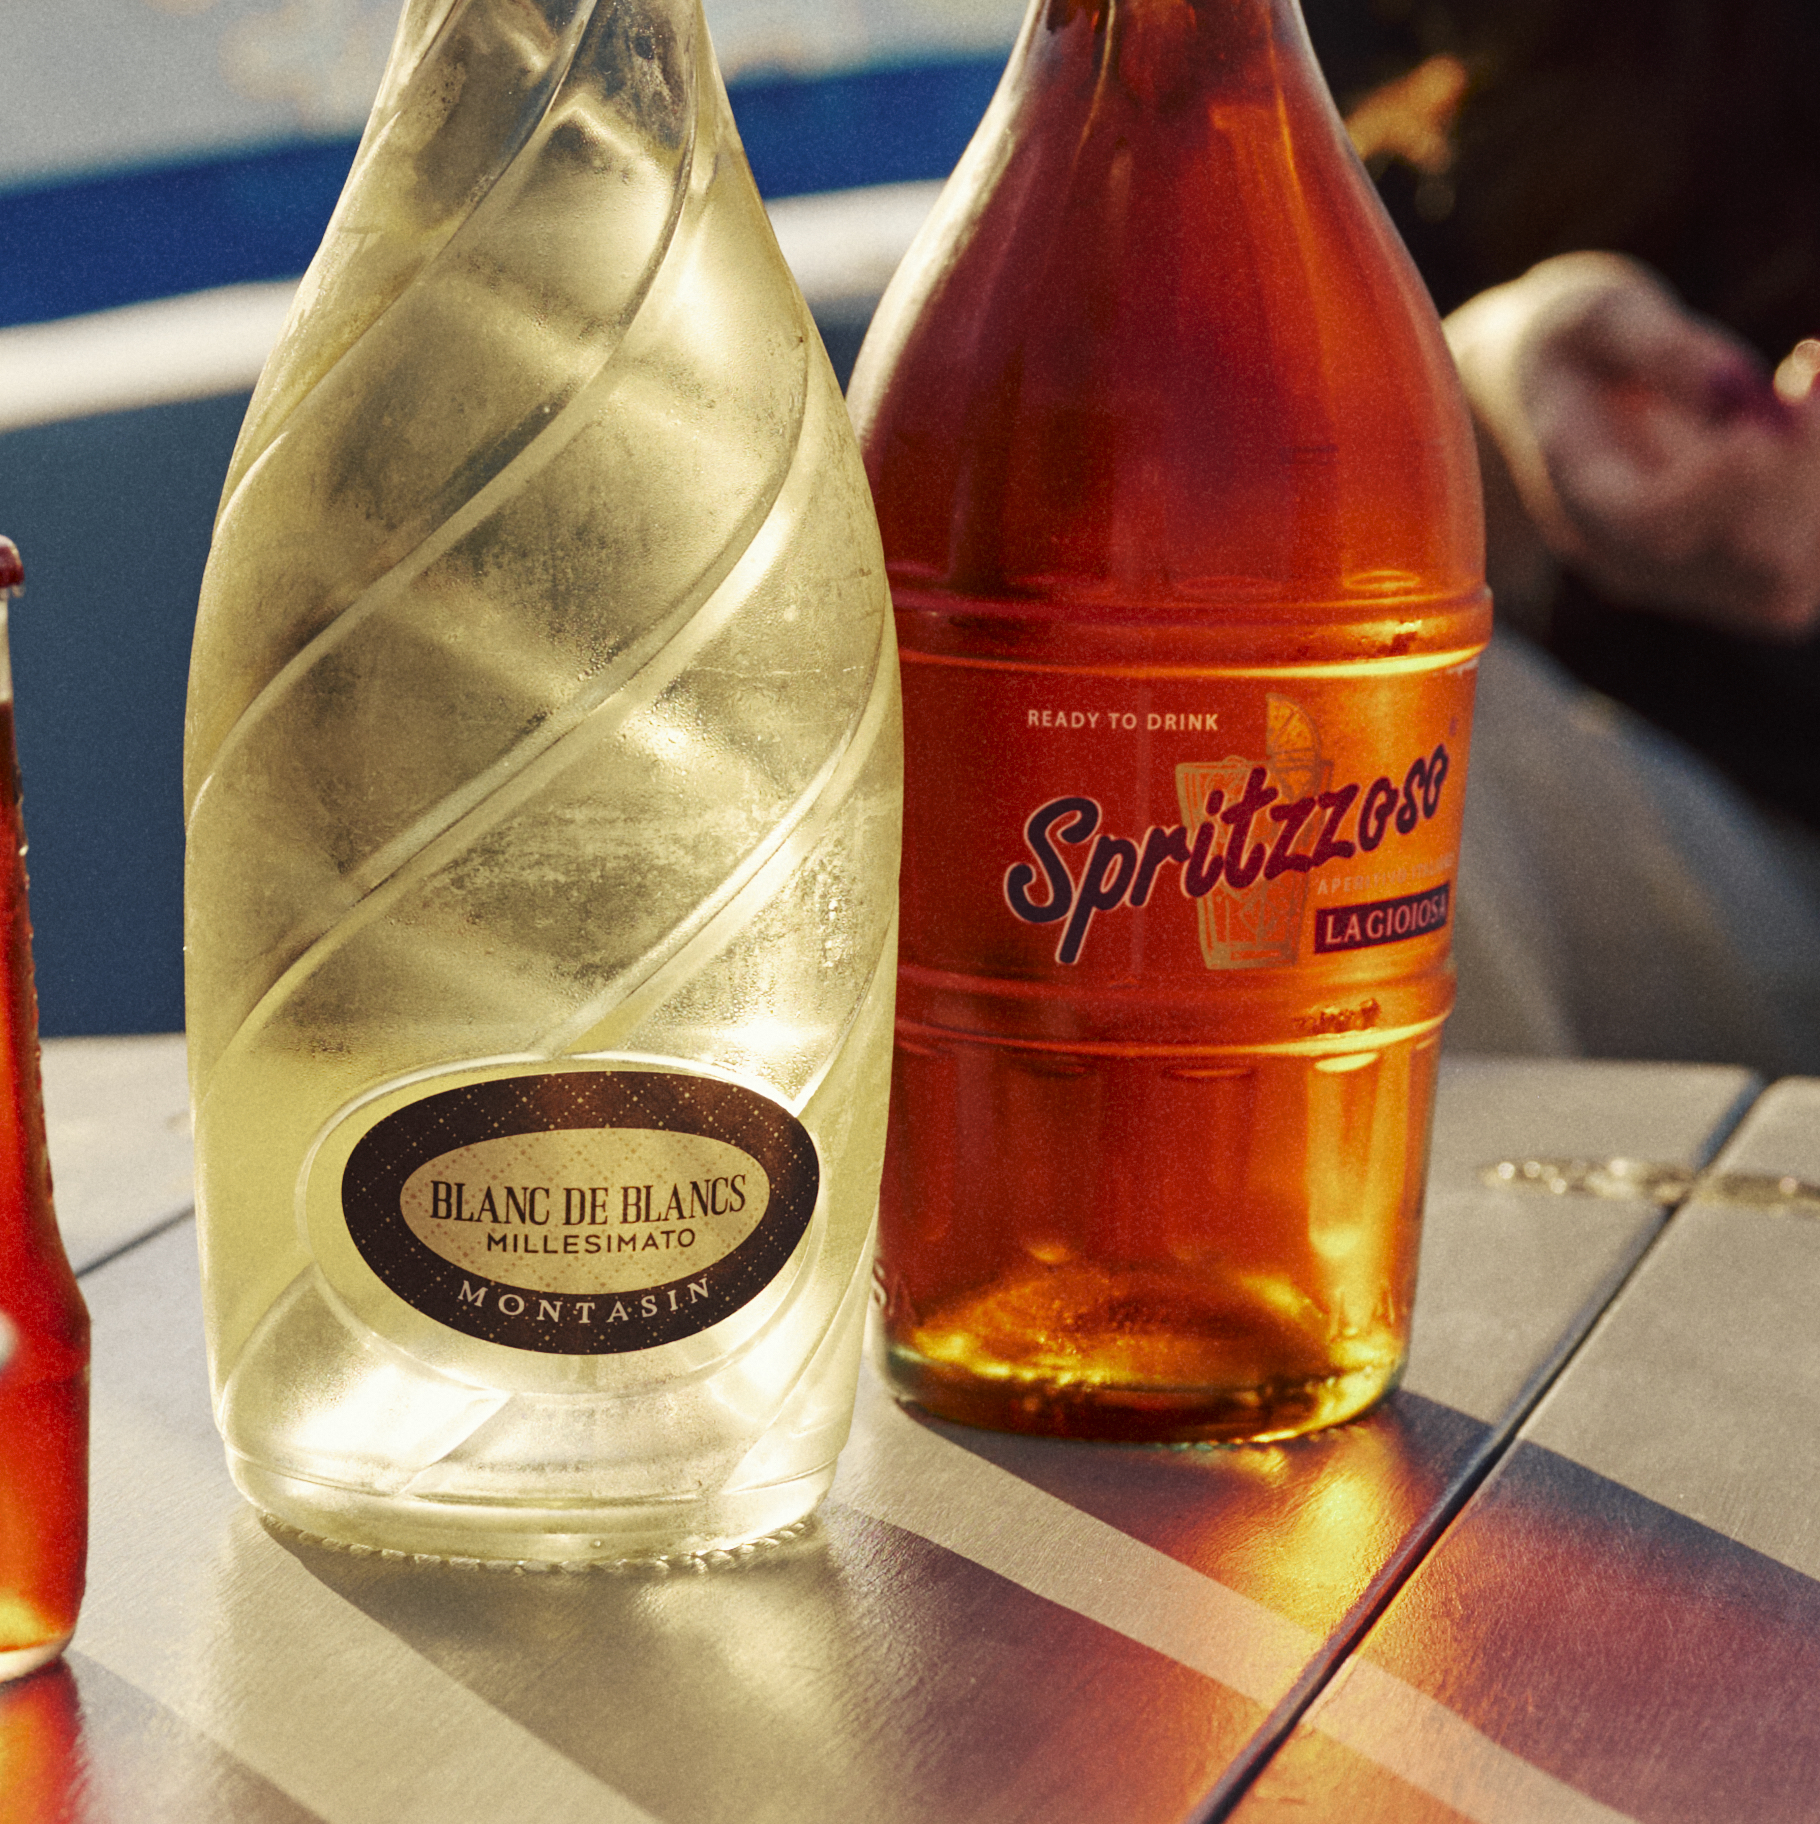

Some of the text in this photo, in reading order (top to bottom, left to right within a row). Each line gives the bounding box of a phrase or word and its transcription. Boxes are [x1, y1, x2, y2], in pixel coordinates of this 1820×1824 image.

[1027, 709, 1219, 731] READY TO DRINK
[1003, 742, 1450, 966] Spritzzoso
[1316, 867, 1408, 896] APERITIVO
[429, 1174, 747, 1226] BLANC DE BLANCS
[487, 1228, 696, 1254] MILLESIMATO
[457, 1277, 714, 1325] MONTASIN
